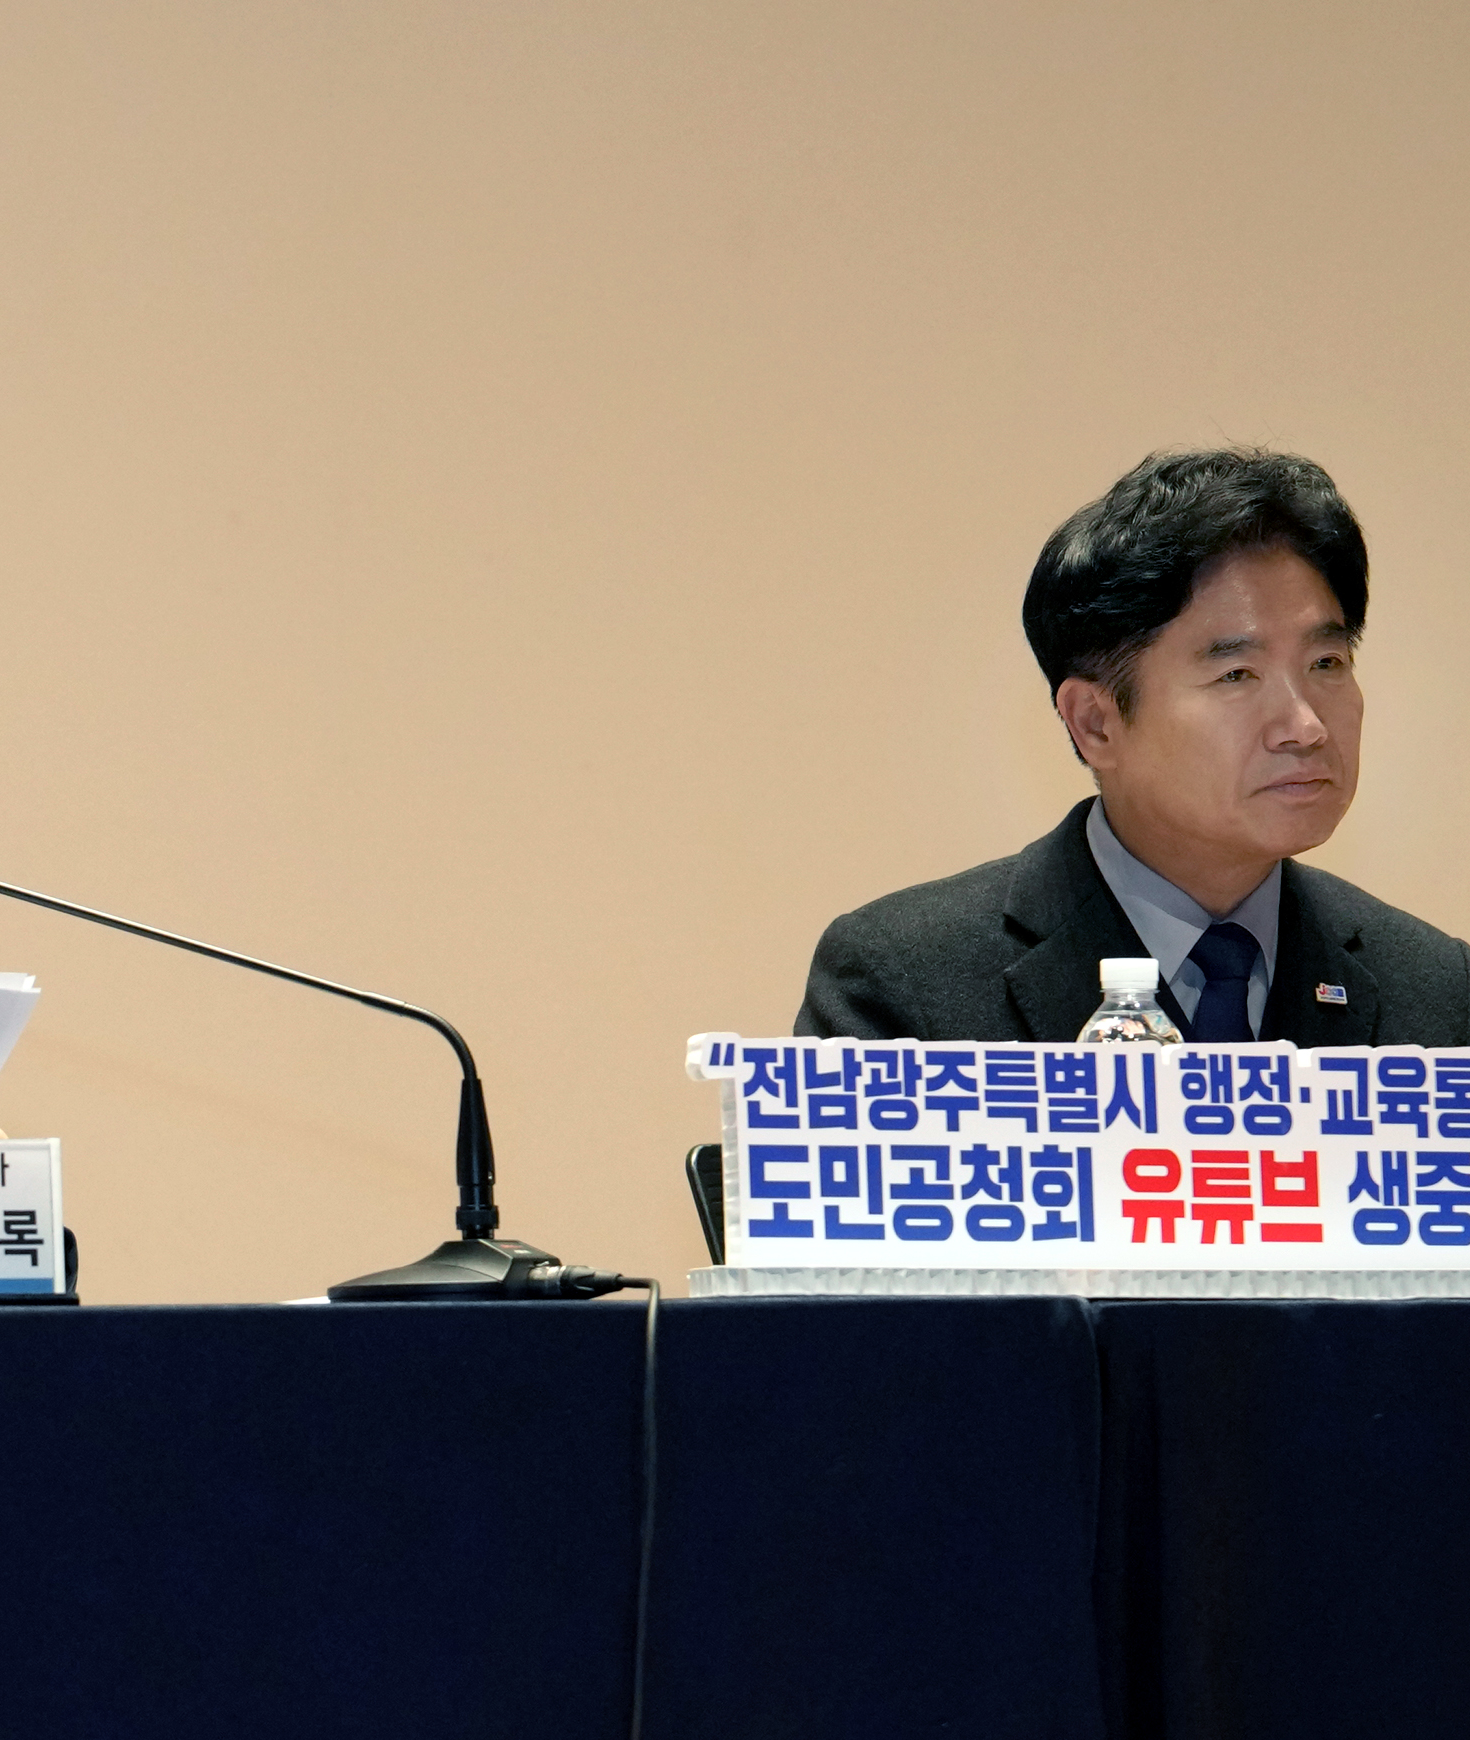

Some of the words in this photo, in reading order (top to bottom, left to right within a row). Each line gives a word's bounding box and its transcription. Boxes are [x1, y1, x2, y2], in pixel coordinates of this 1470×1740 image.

[748, 1144, 1096, 1243] 도민공청회
[1121, 1148, 1324, 1245] 유튜브
[1348, 1151, 1470, 1246] 생중
